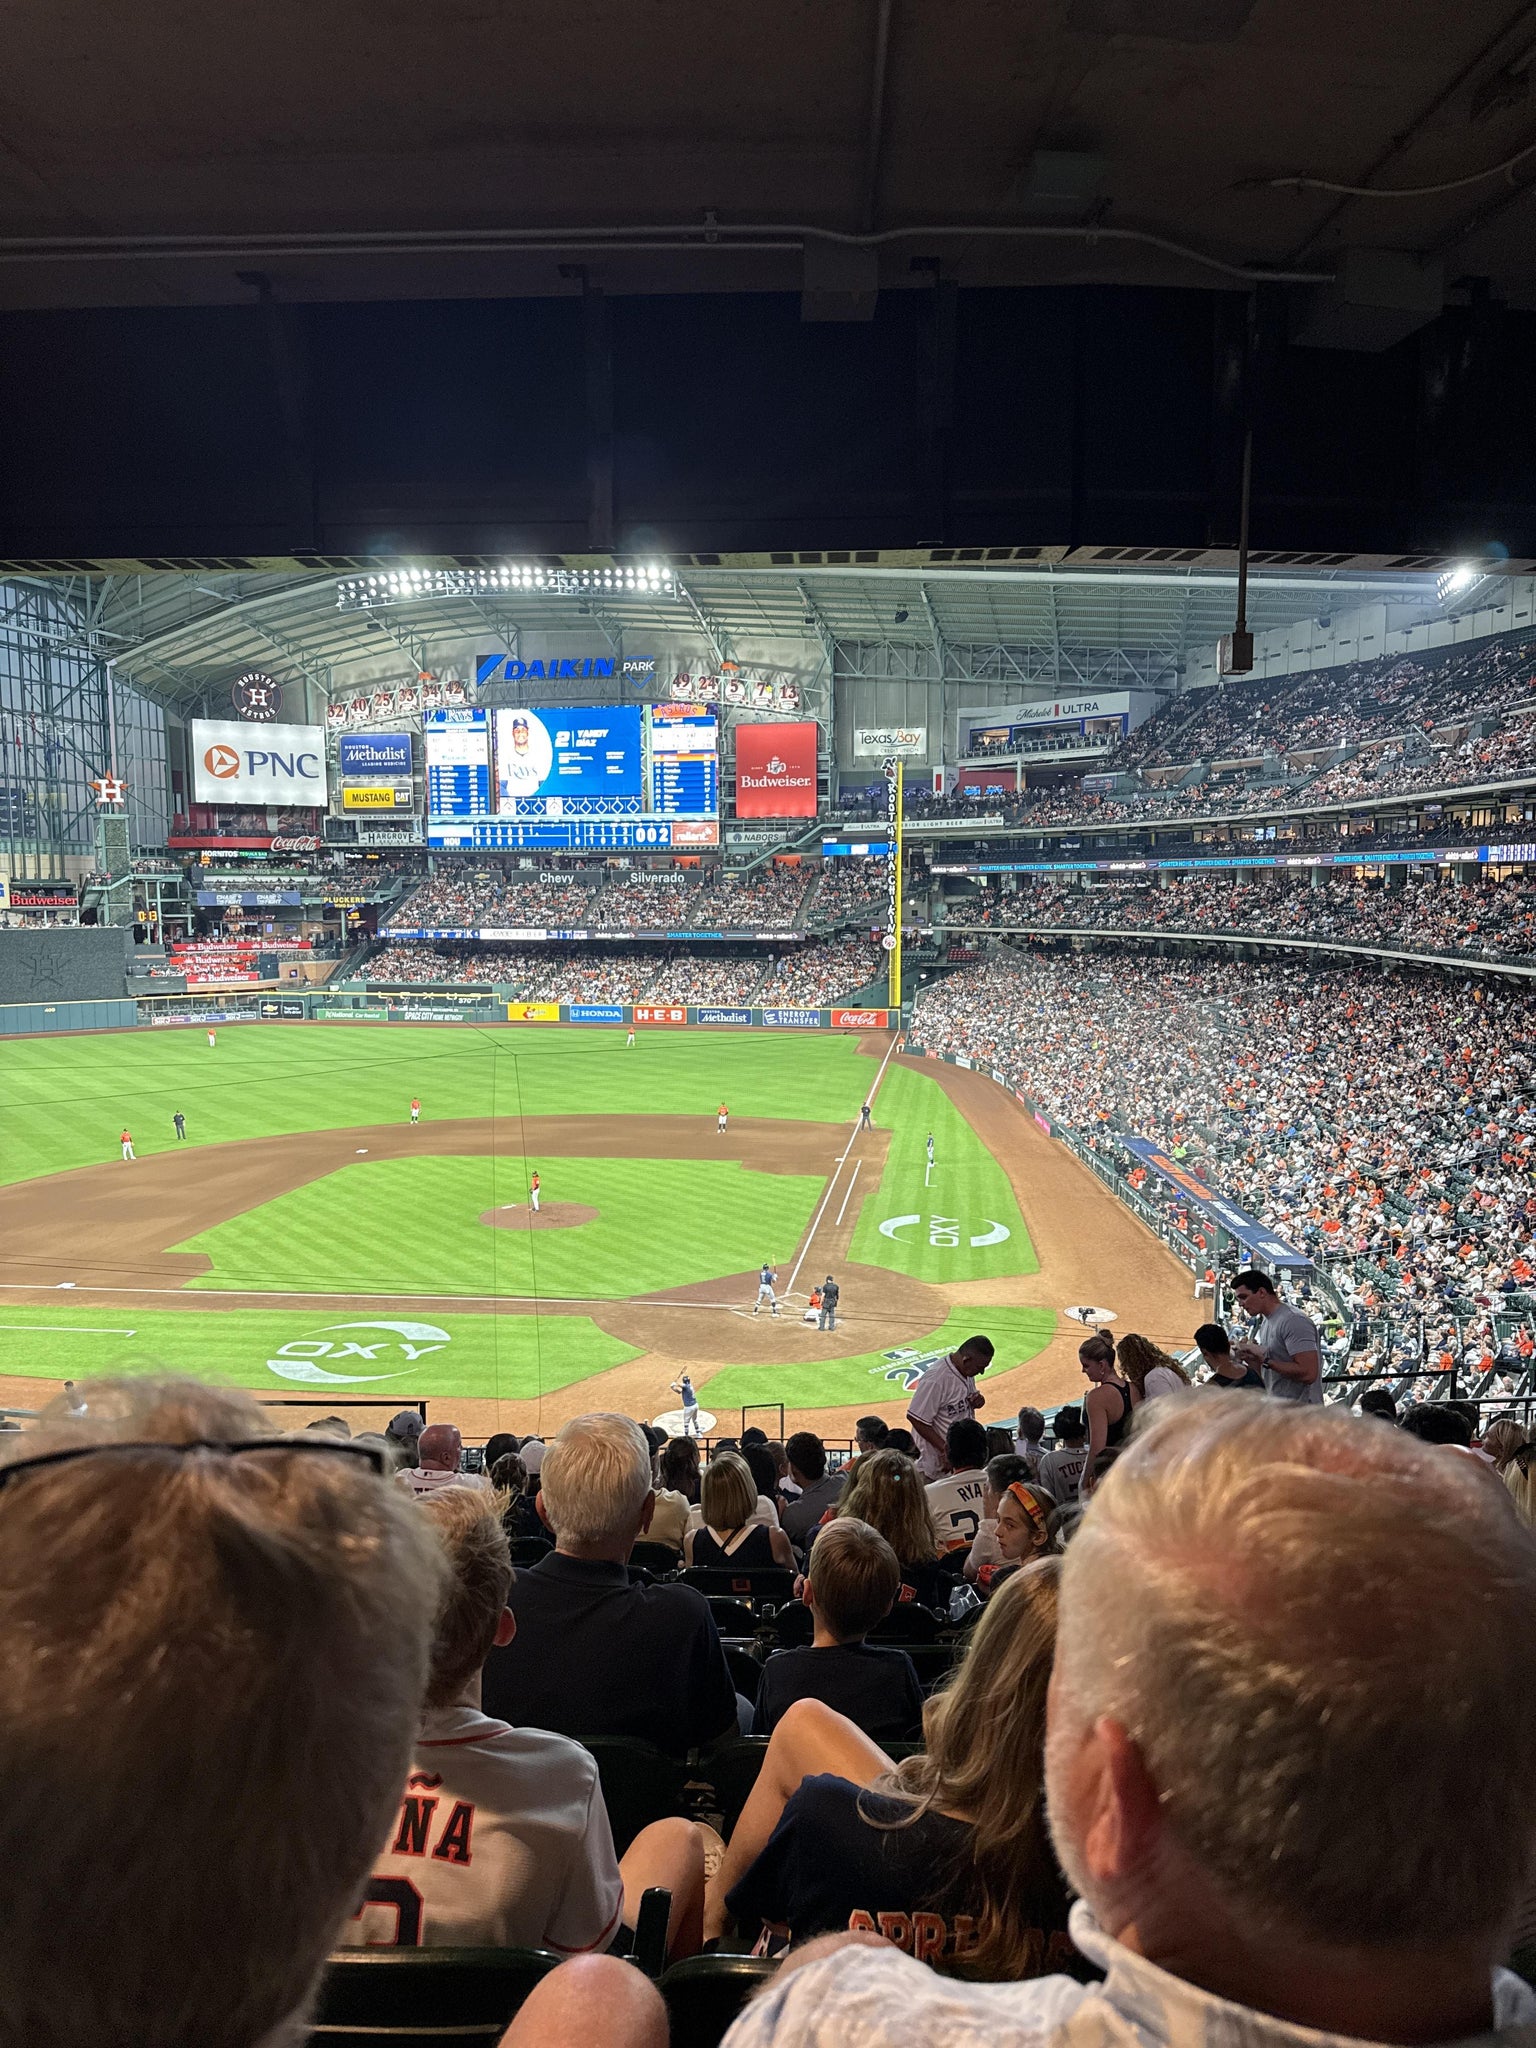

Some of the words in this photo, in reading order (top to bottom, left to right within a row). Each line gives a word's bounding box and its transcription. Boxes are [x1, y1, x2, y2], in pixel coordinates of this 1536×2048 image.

[504, 657, 616, 680] DAIKIN
[623, 661, 655, 672] PARK
[238, 673, 276, 689] HOUSTON
[445, 680, 461, 695] 42
[673, 673, 690, 688] 49
[699, 675, 716, 690] 24
[730, 679, 739, 693] 5
[399, 688, 414, 702] 33
[422, 684, 438, 698] 34
[756, 682, 766, 697] 7
[780, 685, 797, 699] 13
[249, 688, 268, 706] H
[374, 693, 390, 706] 25
[328, 704, 344, 718] 32
[351, 698, 367, 712] 40
[660, 705, 698, 716] ASTROS
[1015, 708, 1052, 721] Michelob
[1062, 702, 1099, 715] ULTRA
[241, 707, 276, 719] ASTROS
[554, 731, 571, 748] 2
[859, 732, 892, 745] Texas
[897, 729, 921, 747] Bay
[346, 746, 407, 761] Methodist
[243, 750, 320, 779] PNC
[95, 779, 125, 803] H
[352, 793, 390, 802] MUSTANG
[395, 792, 410, 802] CAT
[368, 833, 415, 844] HARGROVE
[443, 837, 460, 846] HOU
[635, 827, 646, 843] 0
[647, 827, 657, 843] 0
[659, 827, 669, 843] 2
[744, 833, 779, 841] NABORS
[539, 873, 575, 885] Chevy
[630, 872, 685, 884] Silverado
[10, 895, 77, 906] Budweiser
[262, 941, 299, 949] Budweiser
[208, 974, 250, 982] Budweiser
[404, 1012, 421, 1020] SPACE
[421, 1012, 433, 1020] CITY
[636, 1009, 683, 1021] H-E-B
[701, 1012, 748, 1023] Methodist
[778, 1017, 818, 1025] TRANSFER
[929, 1214, 960, 1247] OXY
[275, 1341, 447, 1360] OXY
[1059, 1461, 1085, 1479] TUC
[957, 1483, 986, 1502] RYA
[391, 1772, 476, 1866] ÑA
